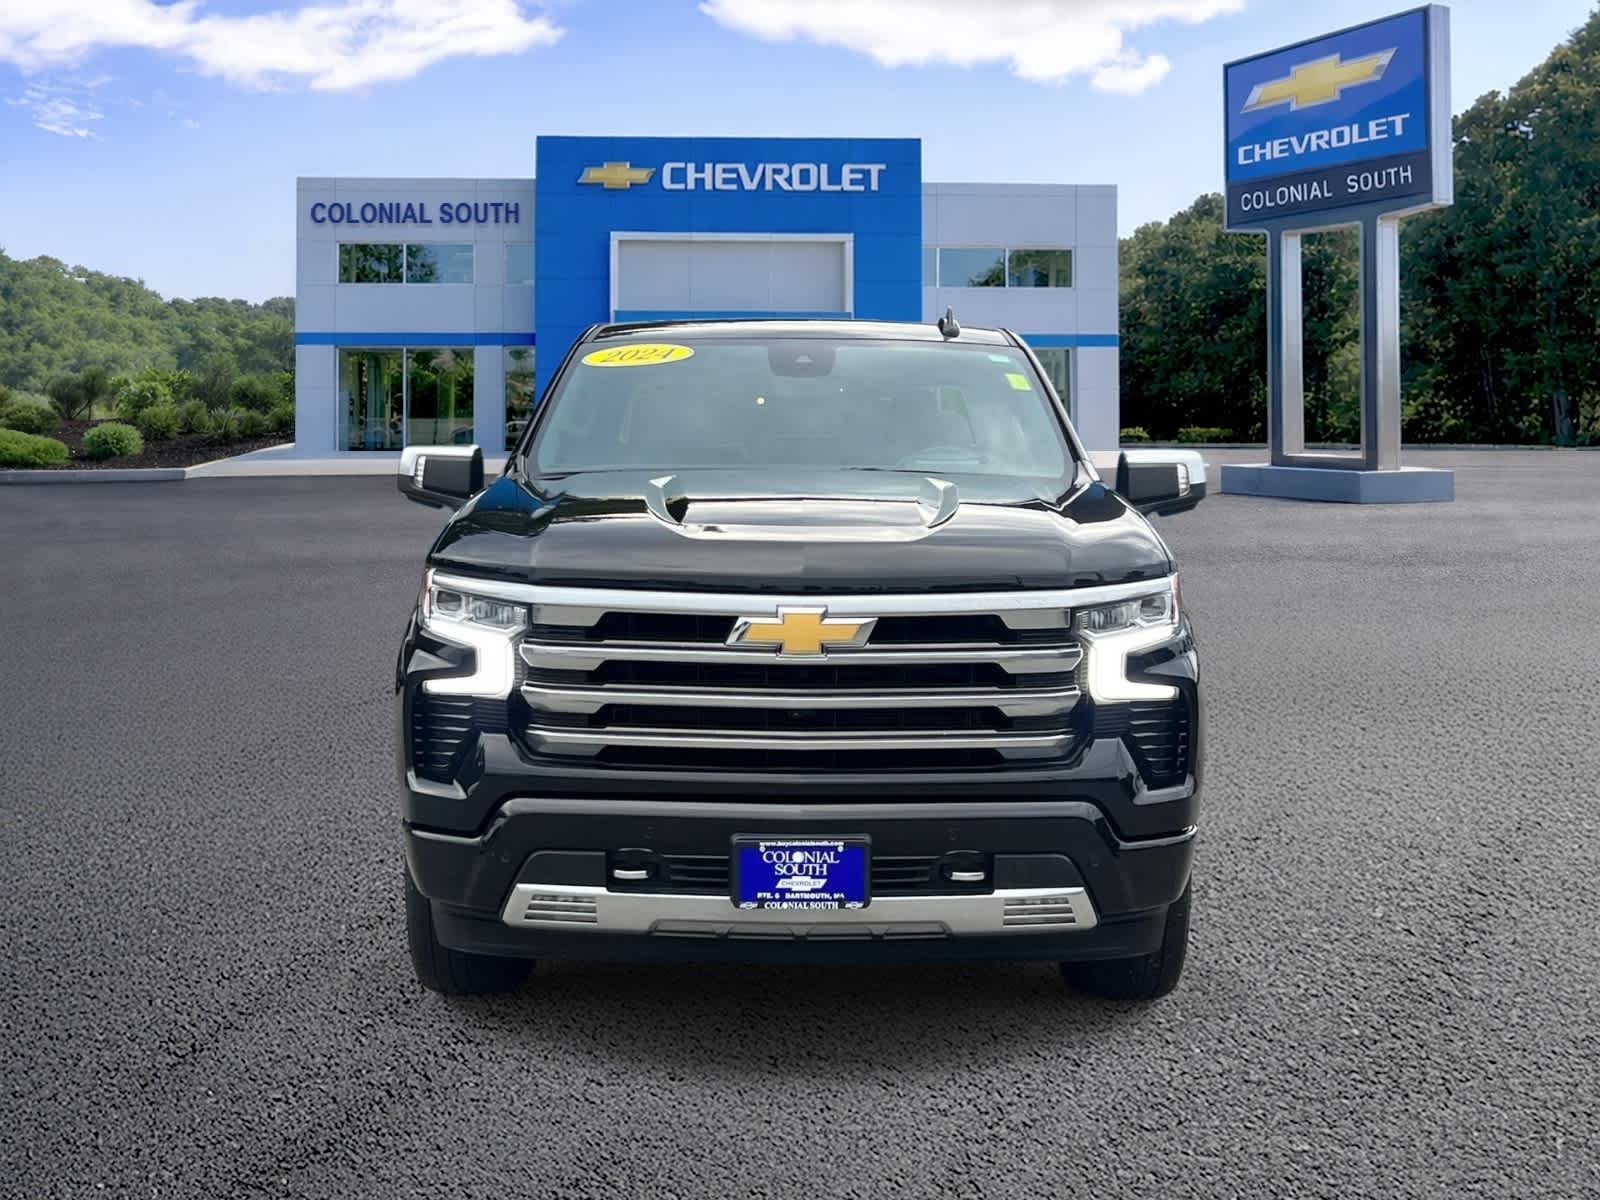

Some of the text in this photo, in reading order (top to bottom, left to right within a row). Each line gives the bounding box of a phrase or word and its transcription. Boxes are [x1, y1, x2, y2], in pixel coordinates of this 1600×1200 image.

[1237, 112, 1410, 165] CHEVROLET
[661, 161, 886, 192] CHEVROLET
[1240, 165, 1413, 211] COLONIAL SOUTH
[310, 202, 520, 224] COLONIAL SOUTH
[599, 348, 677, 363] 2024
[763, 851, 840, 863] COLONIAL
[775, 864, 827, 875] SOUTH
[764, 902, 839, 910] COLONIAL SOUTH
